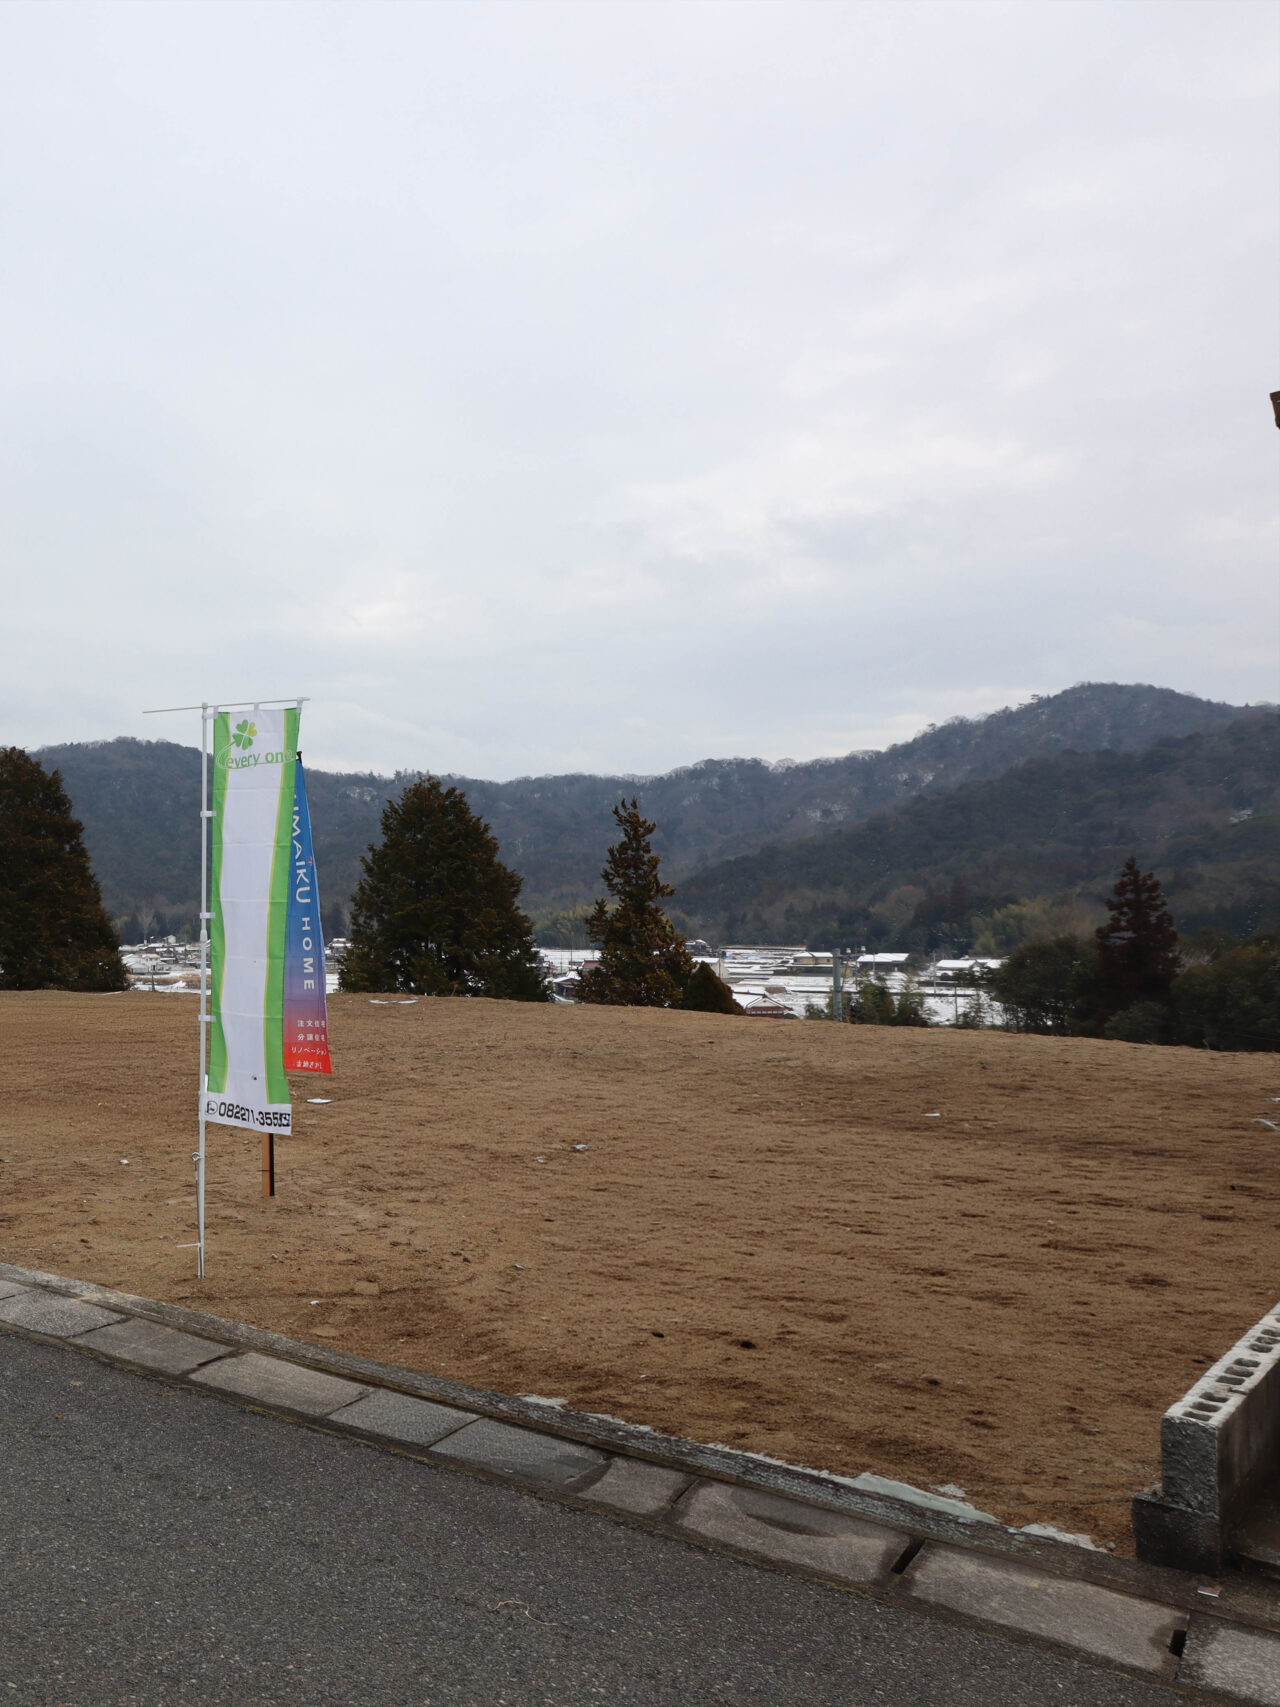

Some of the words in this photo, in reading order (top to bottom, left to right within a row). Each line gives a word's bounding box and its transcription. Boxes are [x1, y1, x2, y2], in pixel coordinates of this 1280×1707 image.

[225, 753, 261, 769] every
[264, 751, 294, 764] one
[292, 794, 311, 903] MAIKU
[301, 917, 315, 990] HOME
